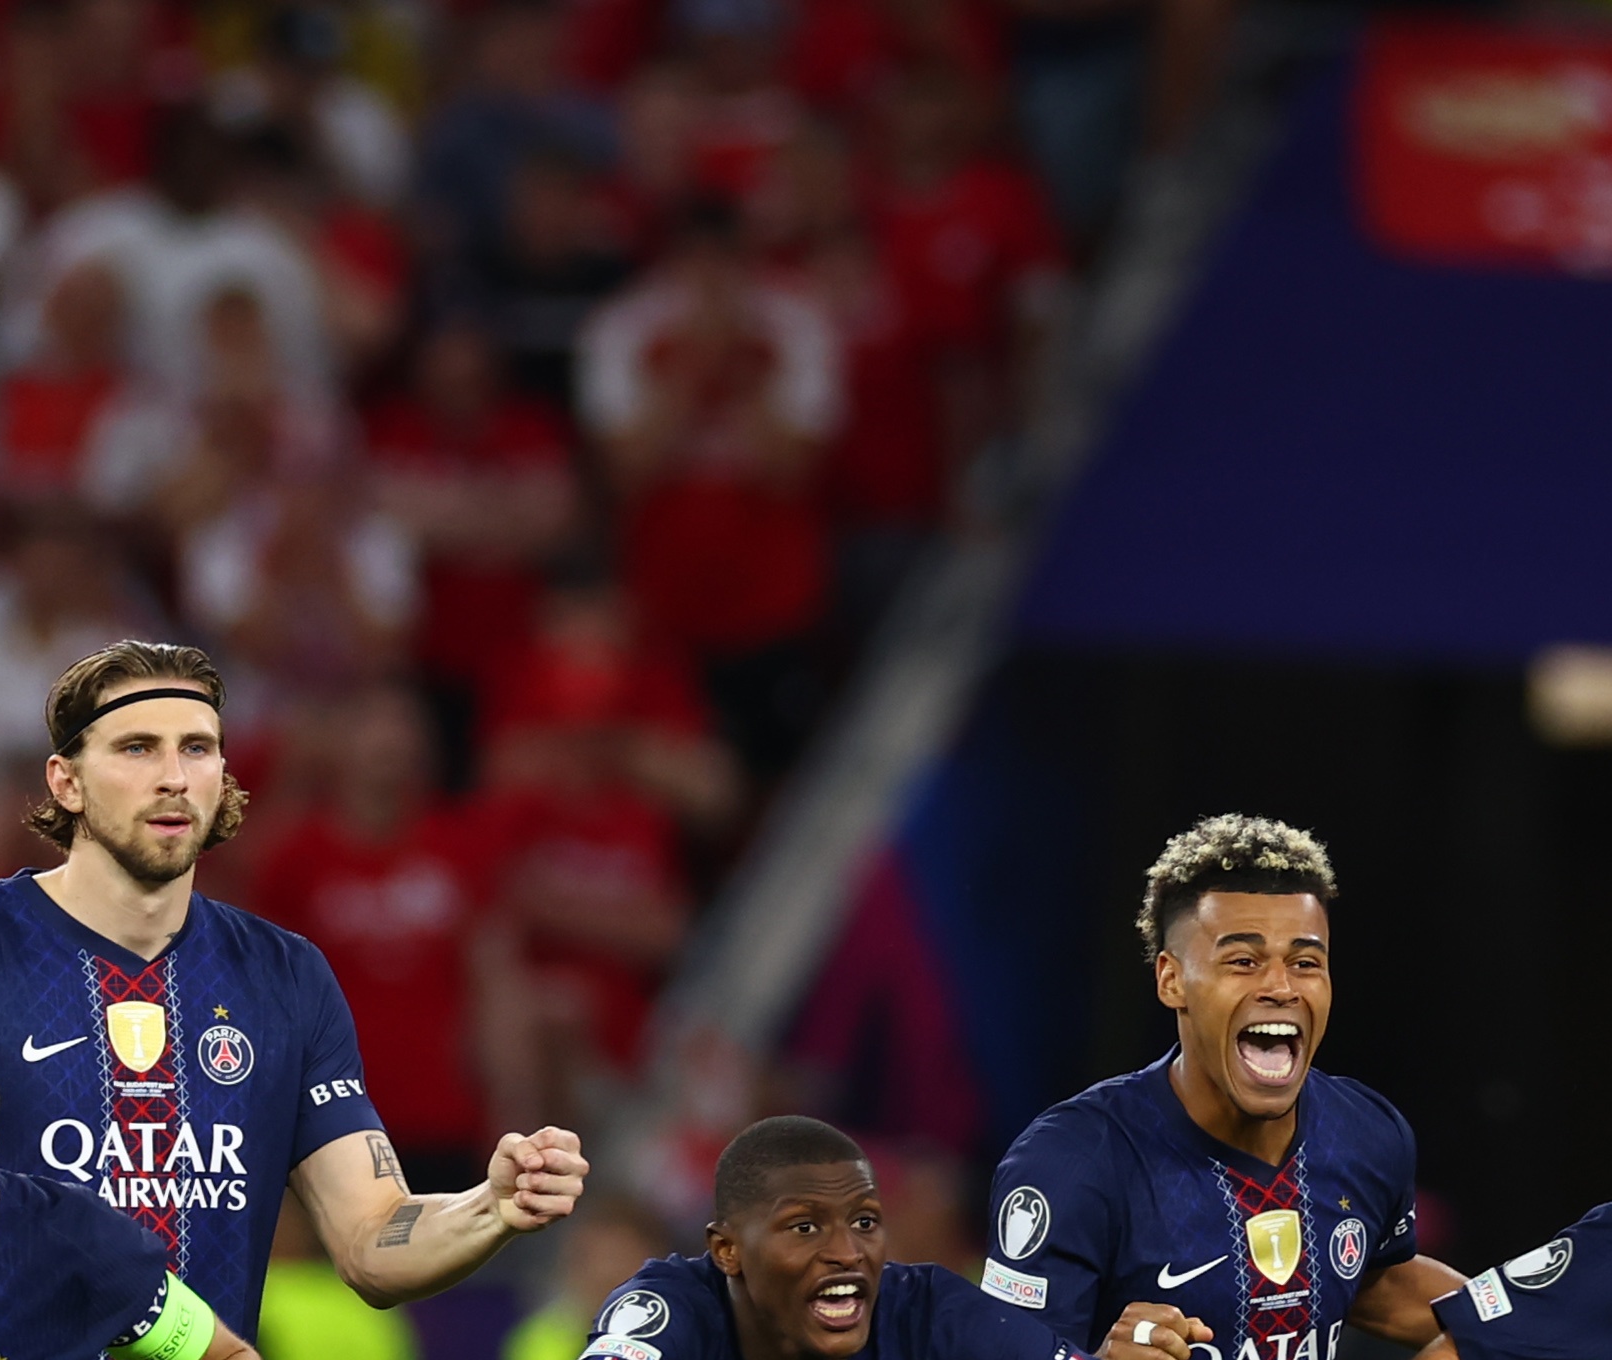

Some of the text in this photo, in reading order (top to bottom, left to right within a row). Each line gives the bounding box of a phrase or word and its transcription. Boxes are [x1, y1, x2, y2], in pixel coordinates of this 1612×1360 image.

[205, 1029, 242, 1044] PARIS
[40, 1117, 248, 1182] QATAR
[97, 1177, 248, 1212] AIRWAYS
[1335, 1221, 1361, 1238] PARIS
